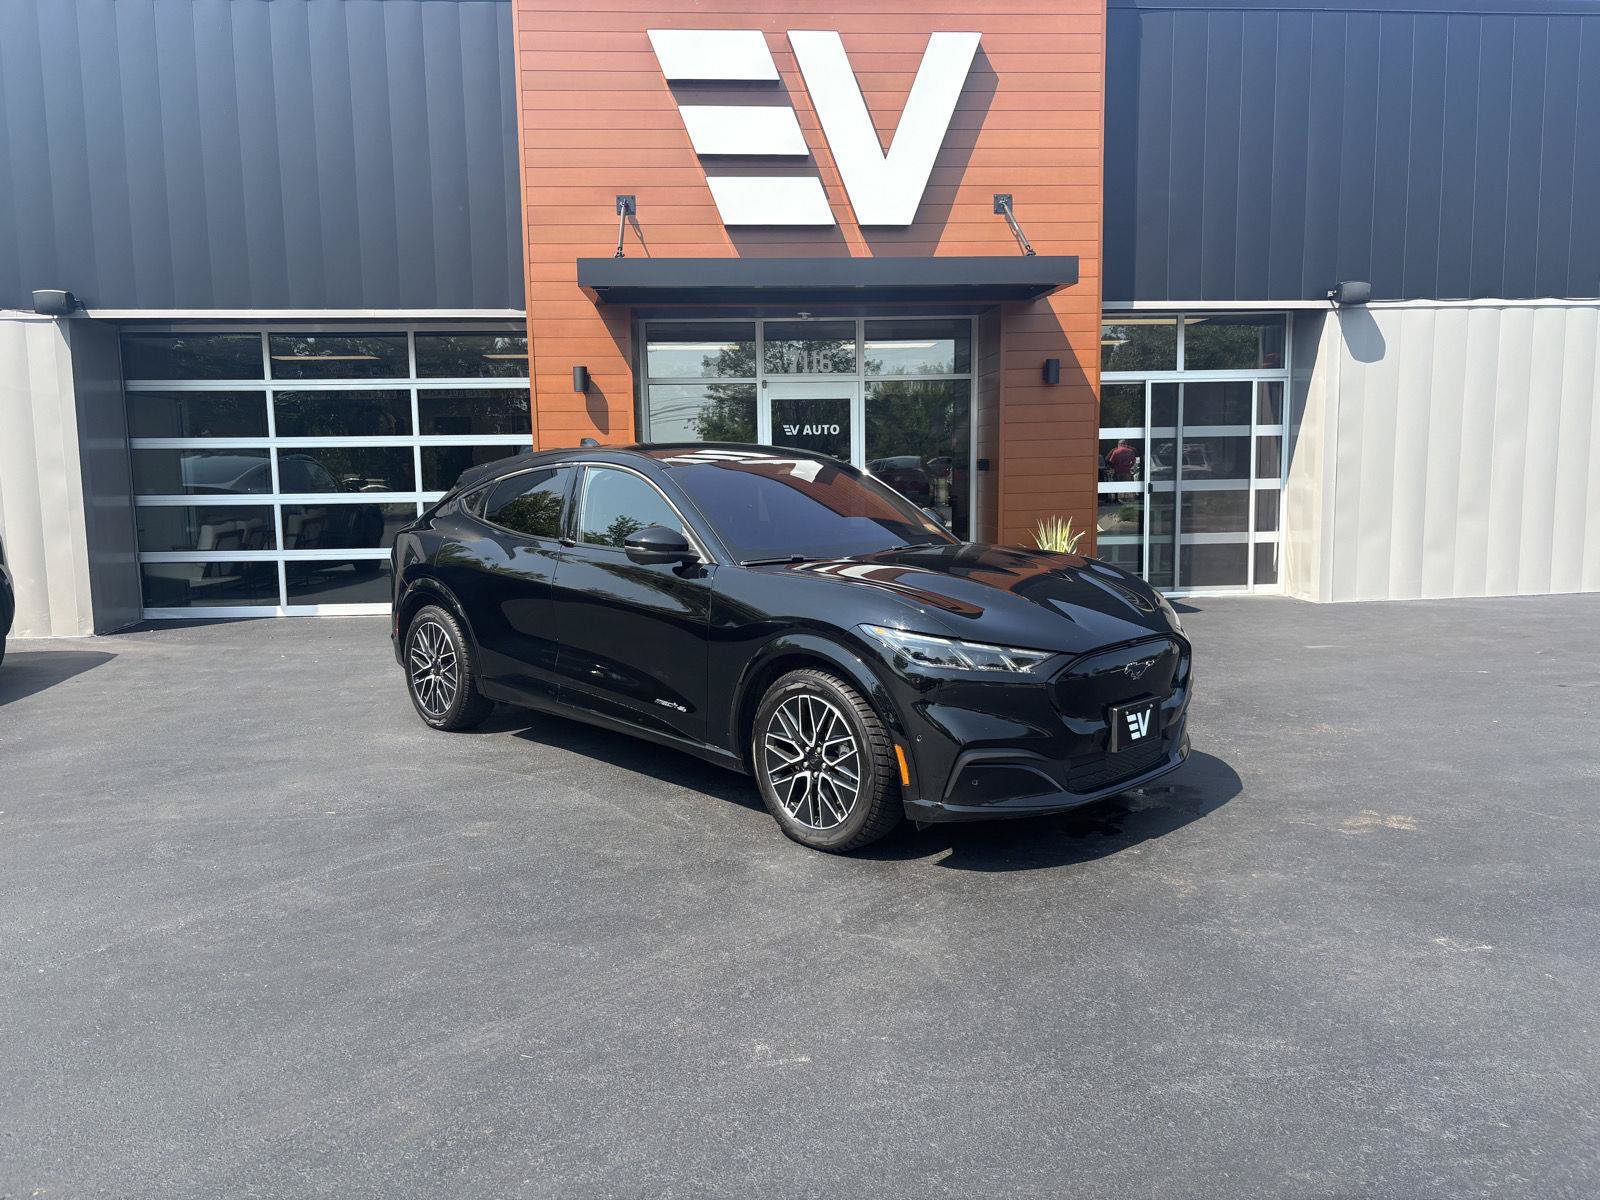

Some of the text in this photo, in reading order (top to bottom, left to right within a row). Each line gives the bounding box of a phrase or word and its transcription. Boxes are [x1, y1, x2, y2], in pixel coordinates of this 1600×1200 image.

[646, 29, 983, 226] EV
[782, 424, 840, 435] EV AUTO
[1126, 709, 1151, 740] EV
